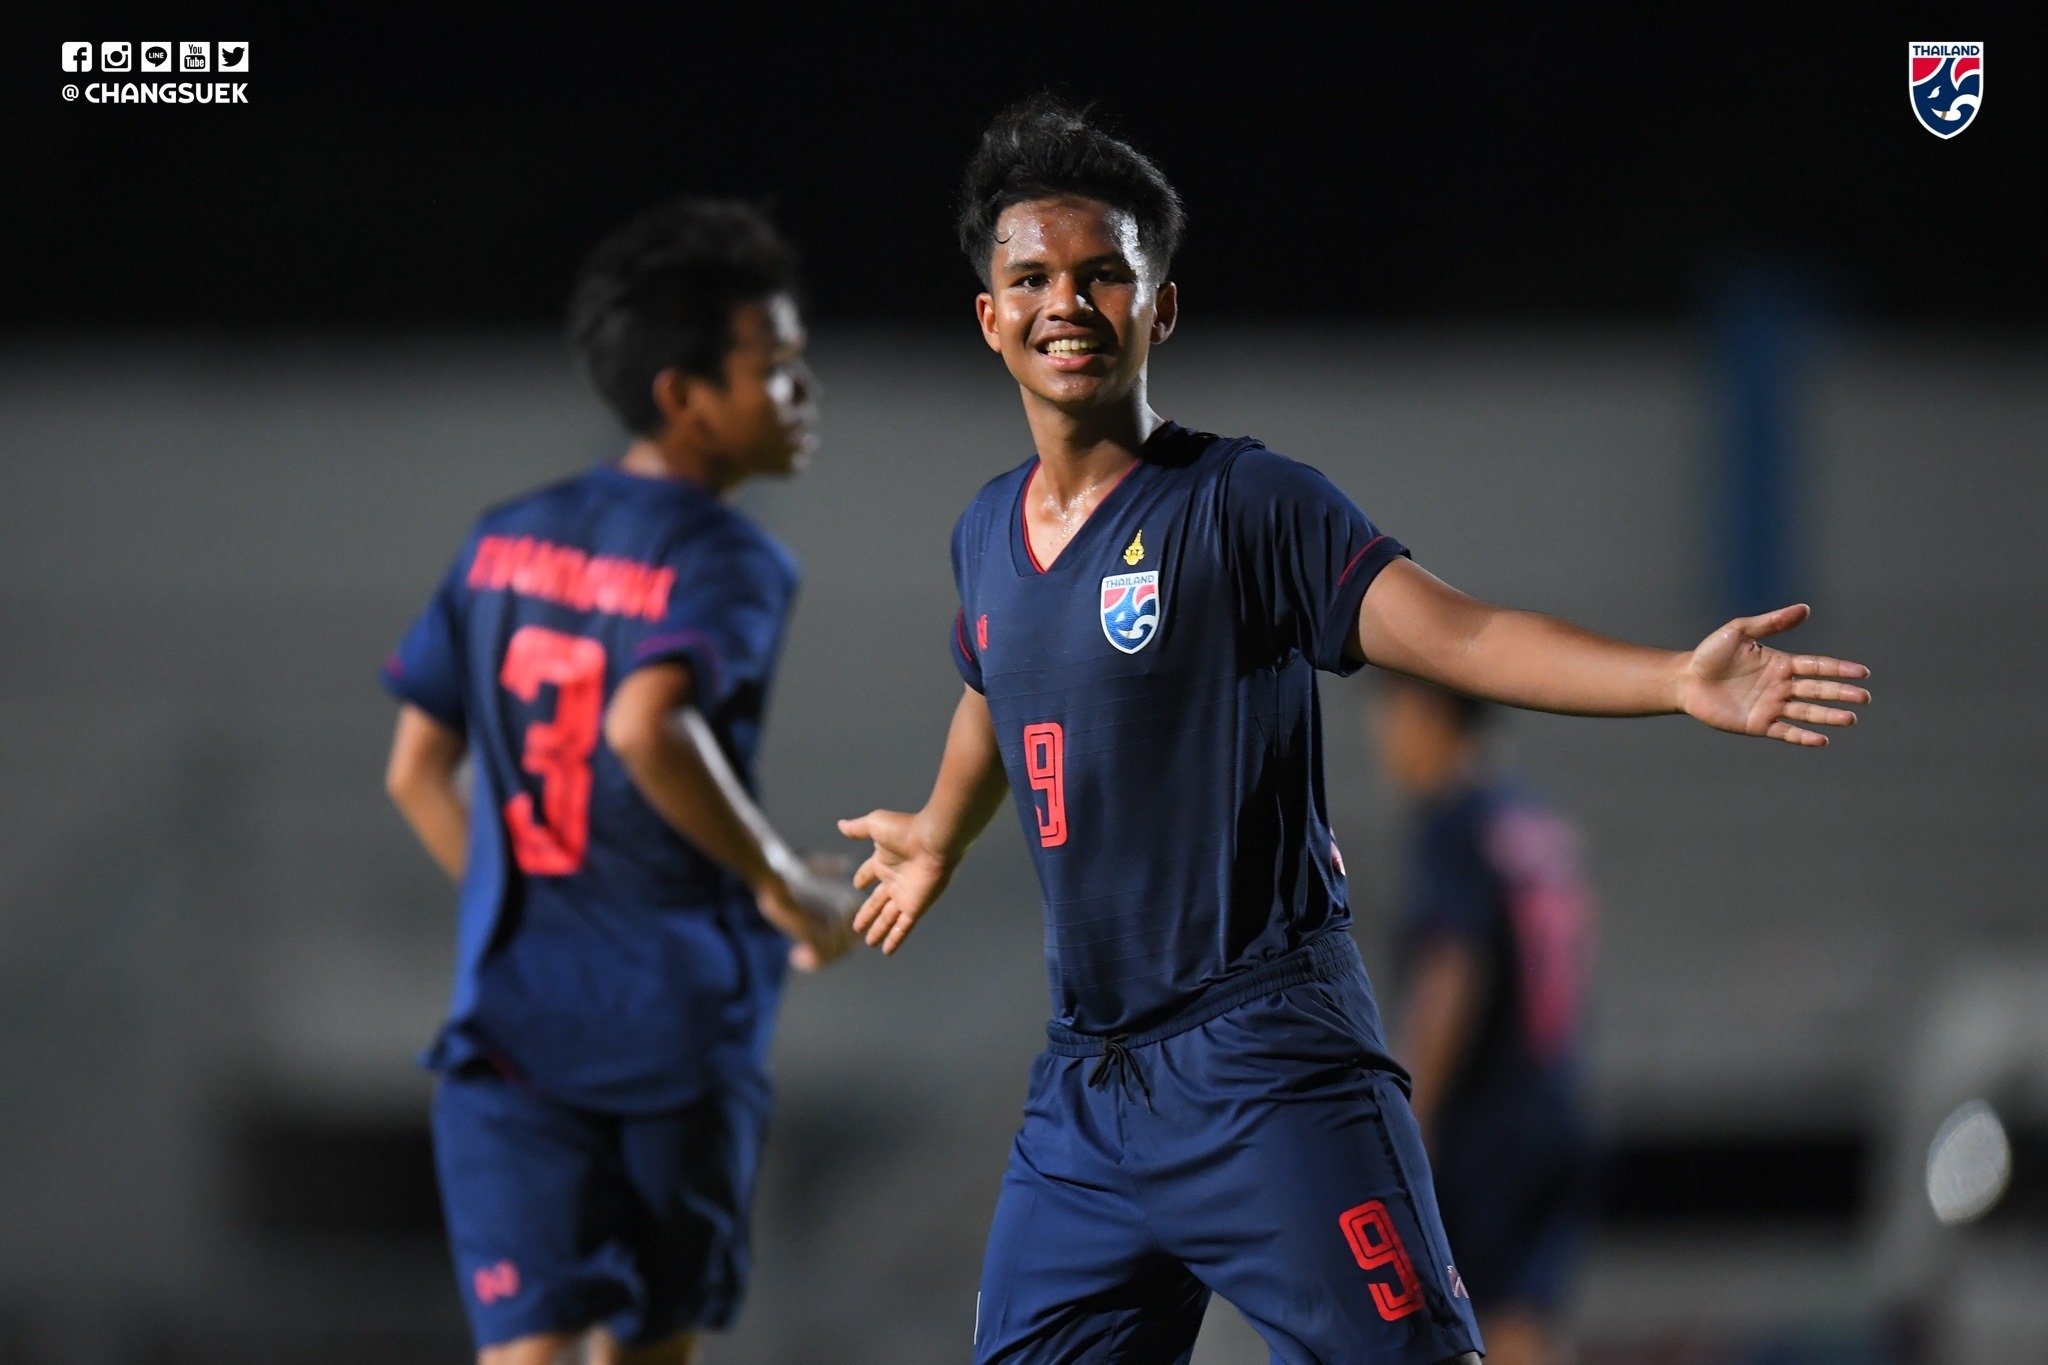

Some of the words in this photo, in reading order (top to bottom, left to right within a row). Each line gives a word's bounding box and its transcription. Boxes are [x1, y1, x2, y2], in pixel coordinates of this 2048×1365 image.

[1105, 575, 1155, 588] THAILAND
[501, 625, 607, 876] 3
[1023, 722, 1068, 848] 9
[1338, 1199, 1425, 1322] 9
